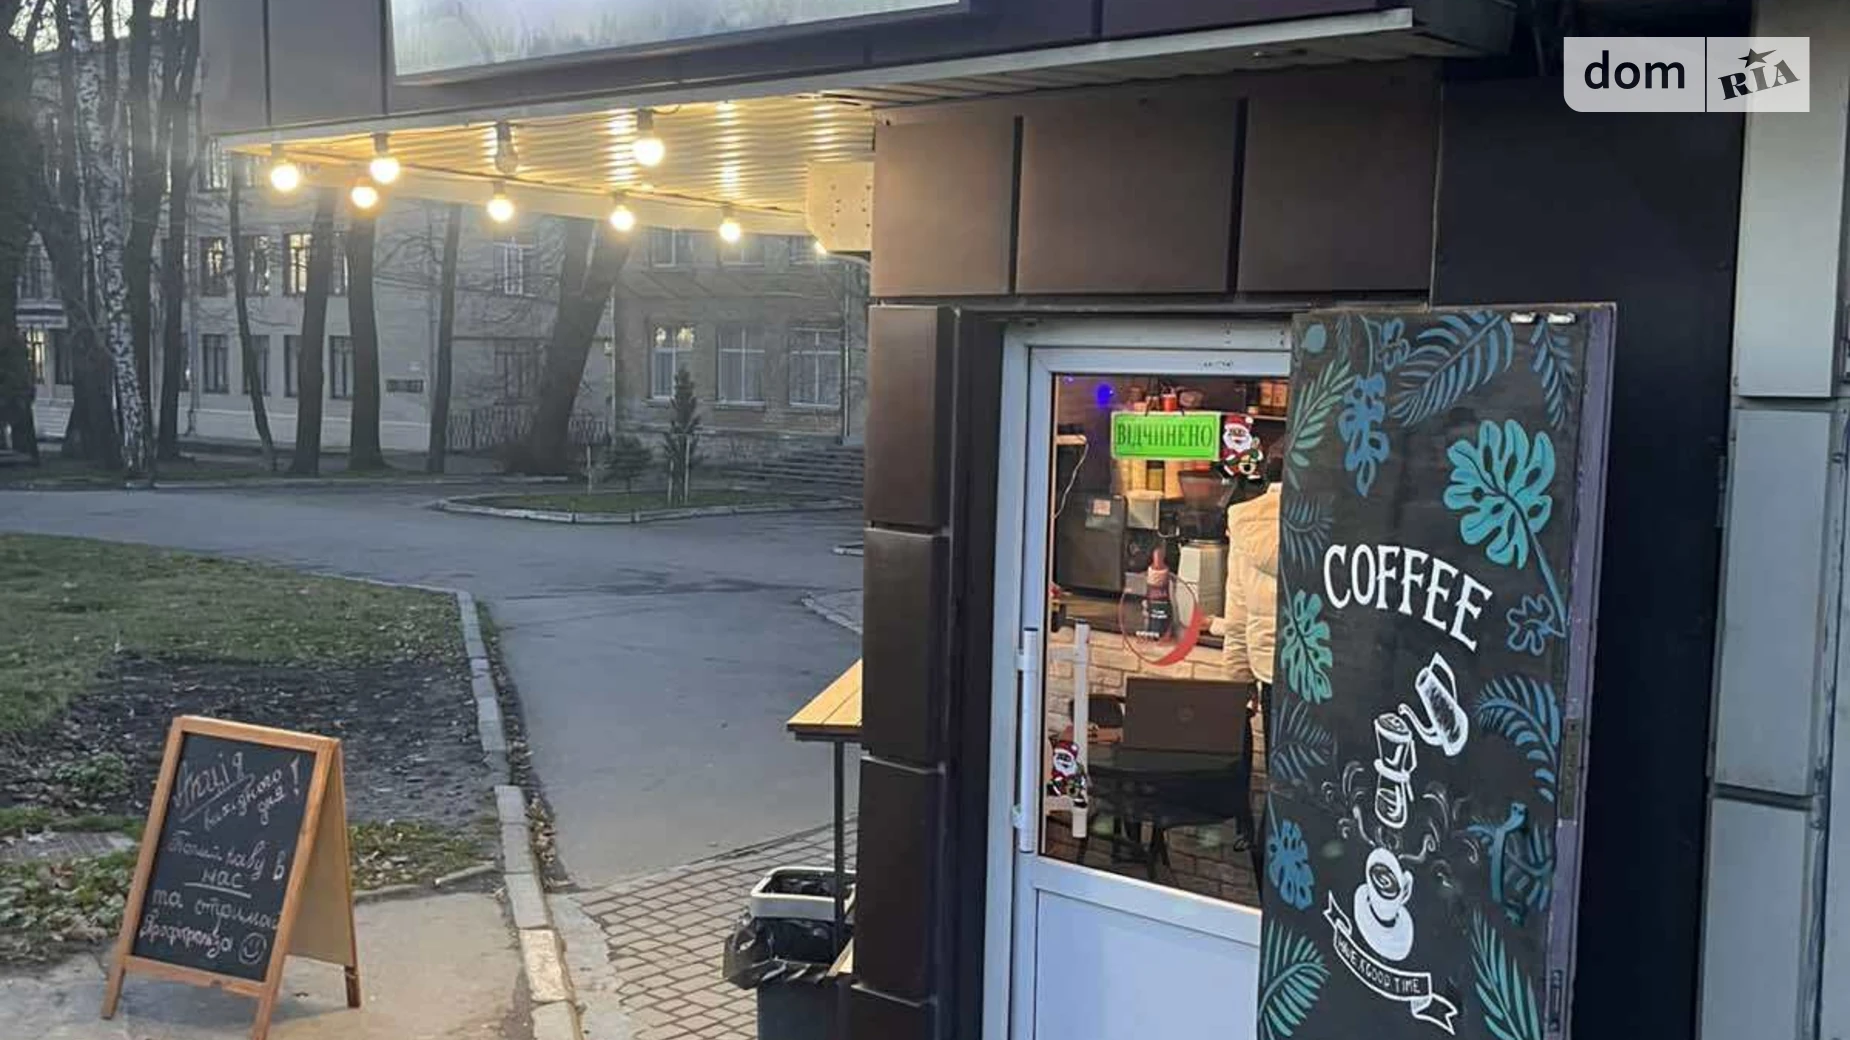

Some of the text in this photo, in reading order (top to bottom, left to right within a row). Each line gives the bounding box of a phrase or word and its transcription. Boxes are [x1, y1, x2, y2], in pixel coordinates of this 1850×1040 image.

[1117, 423, 1213, 448] ВІДЧИНЕНО
[1324, 544, 1493, 652] COFFEE
[1394, 978, 1421, 993] TIME
